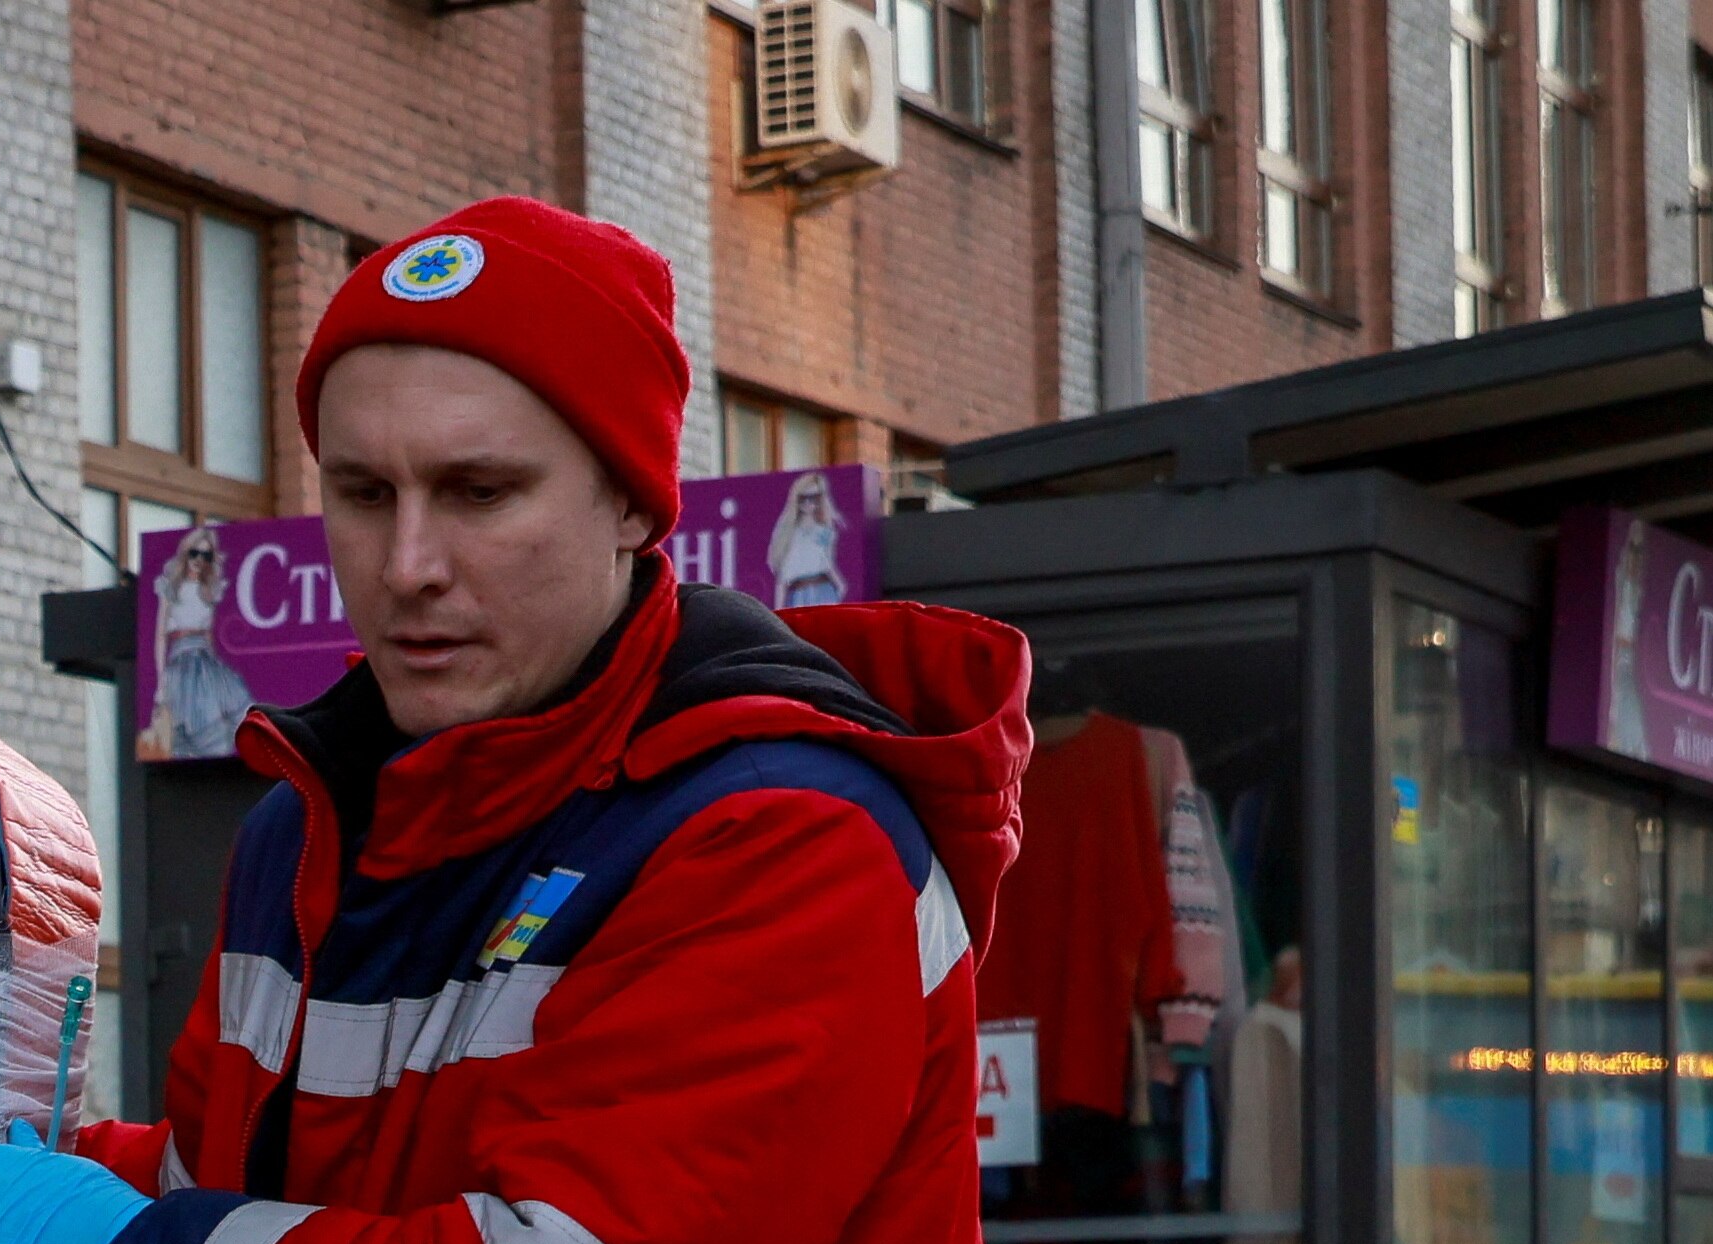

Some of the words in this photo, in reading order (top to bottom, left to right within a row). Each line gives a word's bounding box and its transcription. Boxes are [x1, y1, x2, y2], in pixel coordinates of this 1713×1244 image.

[672, 498, 736, 588] ні
[1667, 560, 1713, 697] Ст
[979, 1054, 1009, 1101] Д
